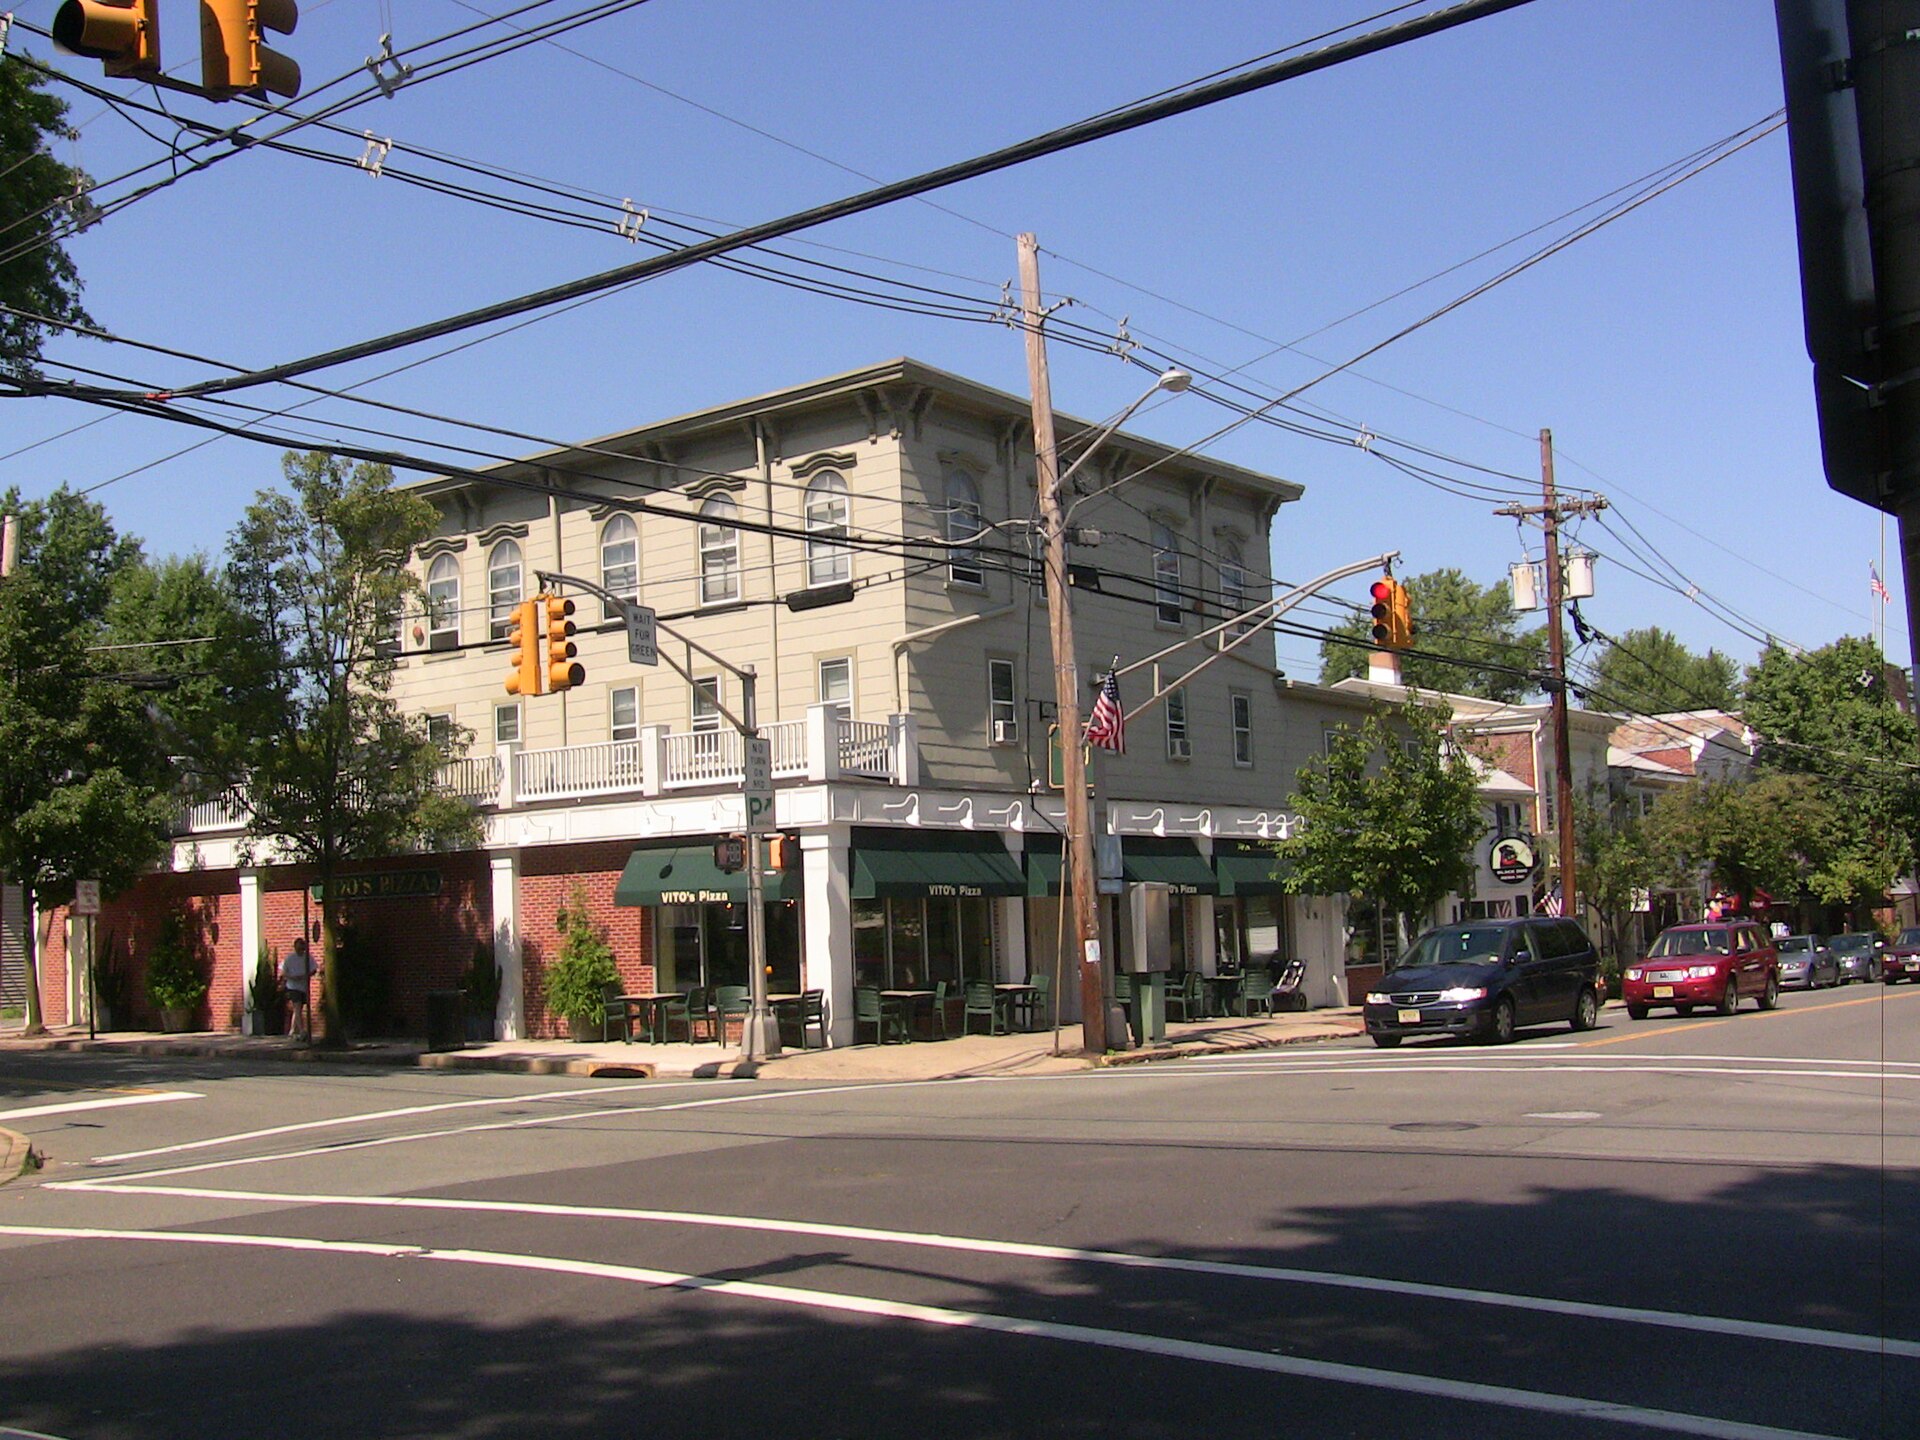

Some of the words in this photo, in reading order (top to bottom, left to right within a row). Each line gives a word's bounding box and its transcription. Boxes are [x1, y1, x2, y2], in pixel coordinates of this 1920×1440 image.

[633, 614, 651, 625] WAIT
[635, 629, 650, 640] FOR
[631, 644, 656, 657] GREEN
[752, 743, 764, 754] NO
[749, 797, 762, 826] P
[379, 874, 431, 894] PIZZA
[928, 884, 956, 896] VITO's
[959, 884, 982, 896] Pizza
[1180, 884, 1198, 894] Pizza
[661, 890, 696, 904] VITO's
[698, 890, 729, 902] Pizza
